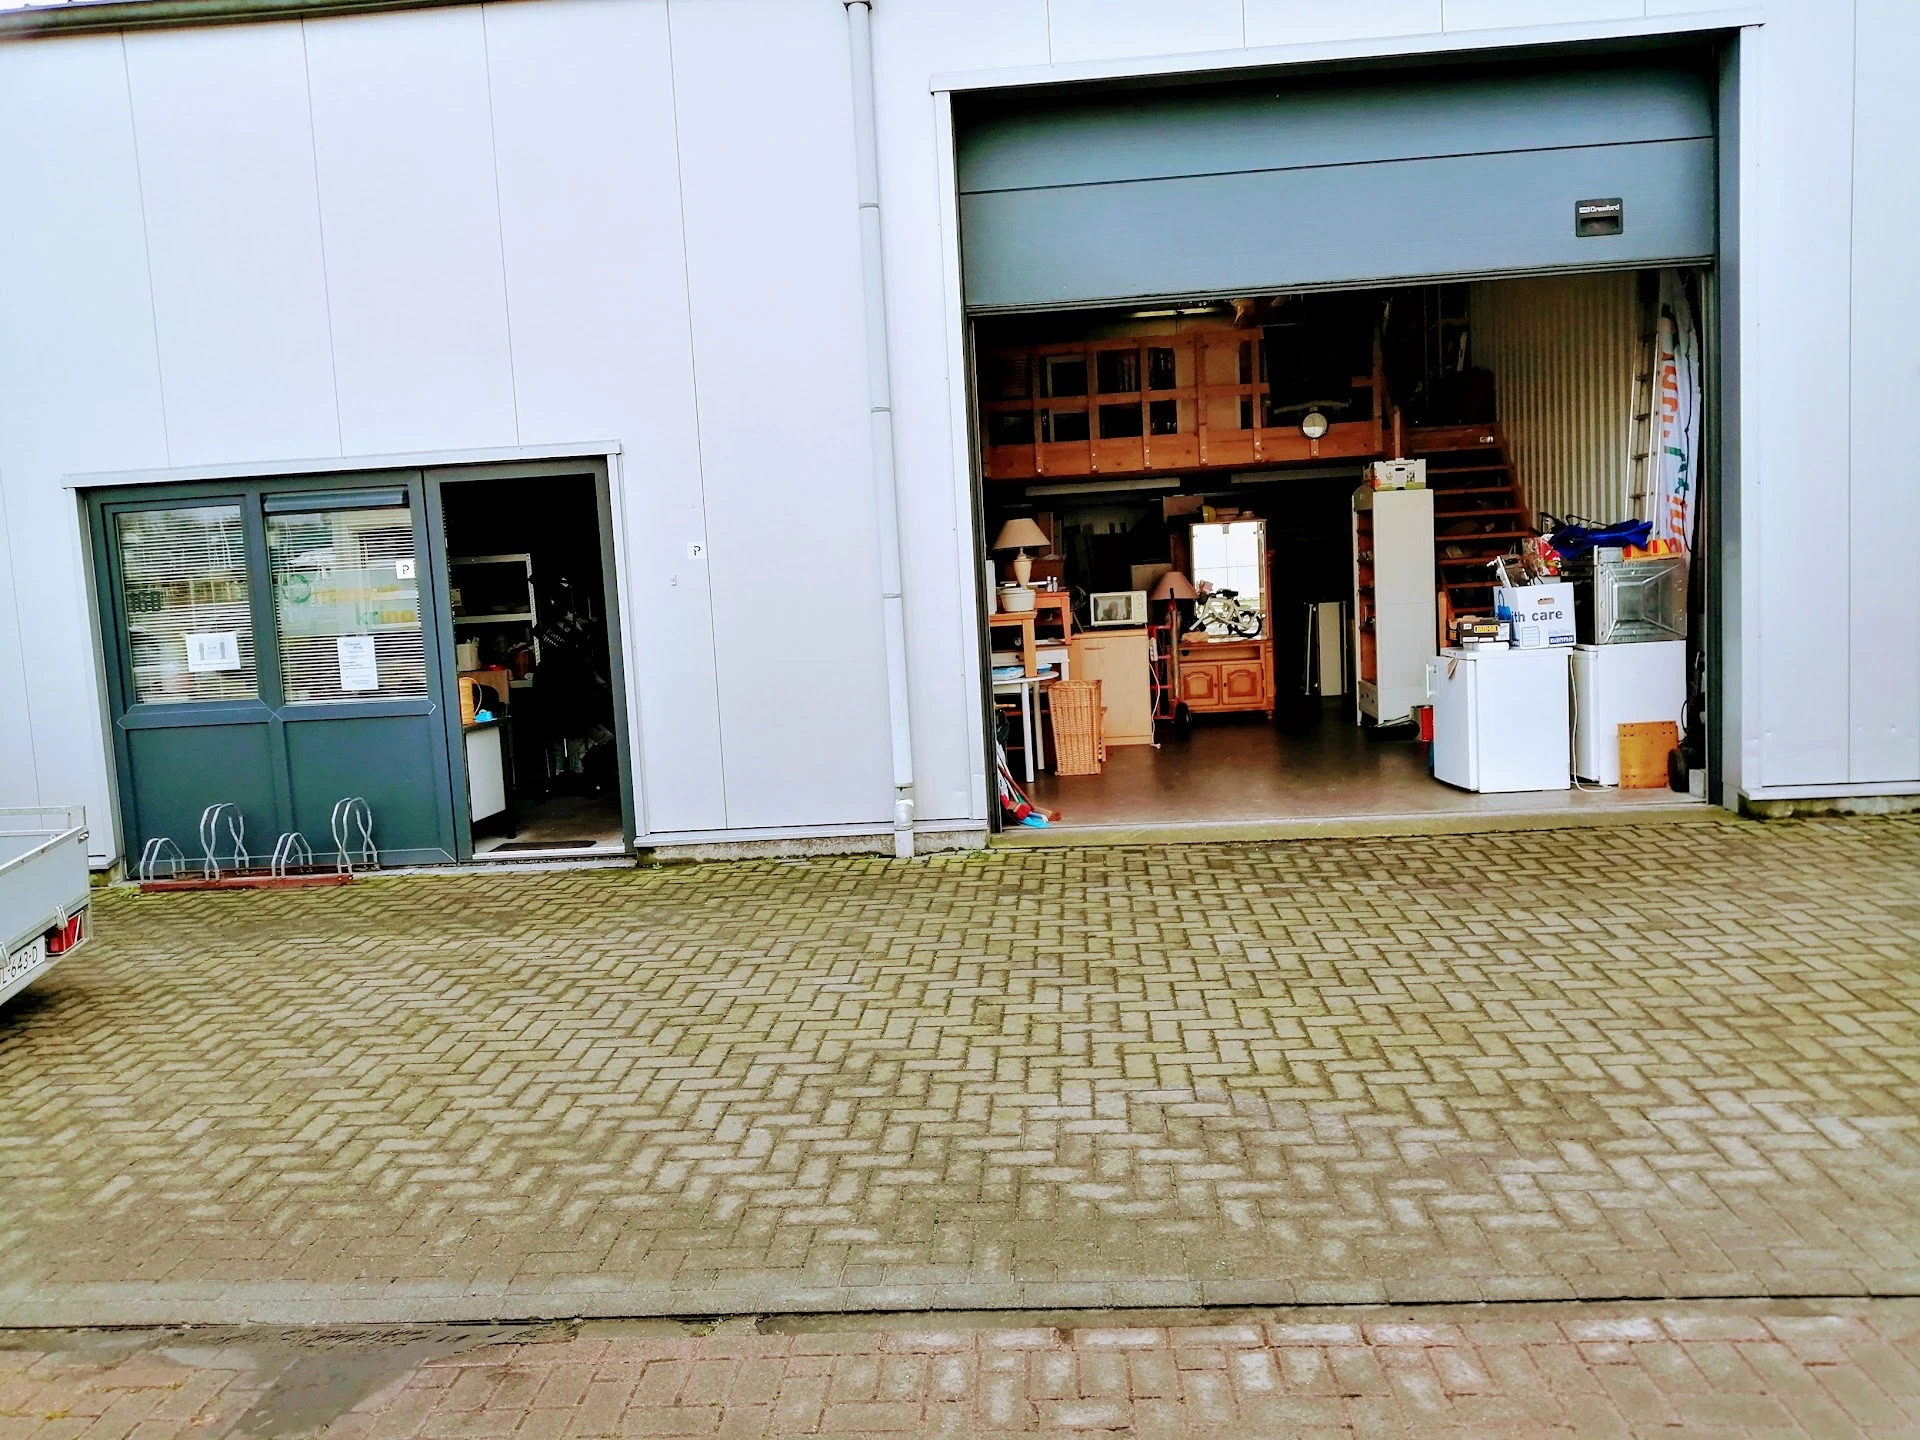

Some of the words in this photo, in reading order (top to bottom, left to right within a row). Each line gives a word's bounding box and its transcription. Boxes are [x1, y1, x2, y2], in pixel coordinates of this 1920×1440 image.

[1590, 203, 1620, 213] Crawford
[1511, 611, 1526, 623] ith
[1532, 610, 1563, 621] care
